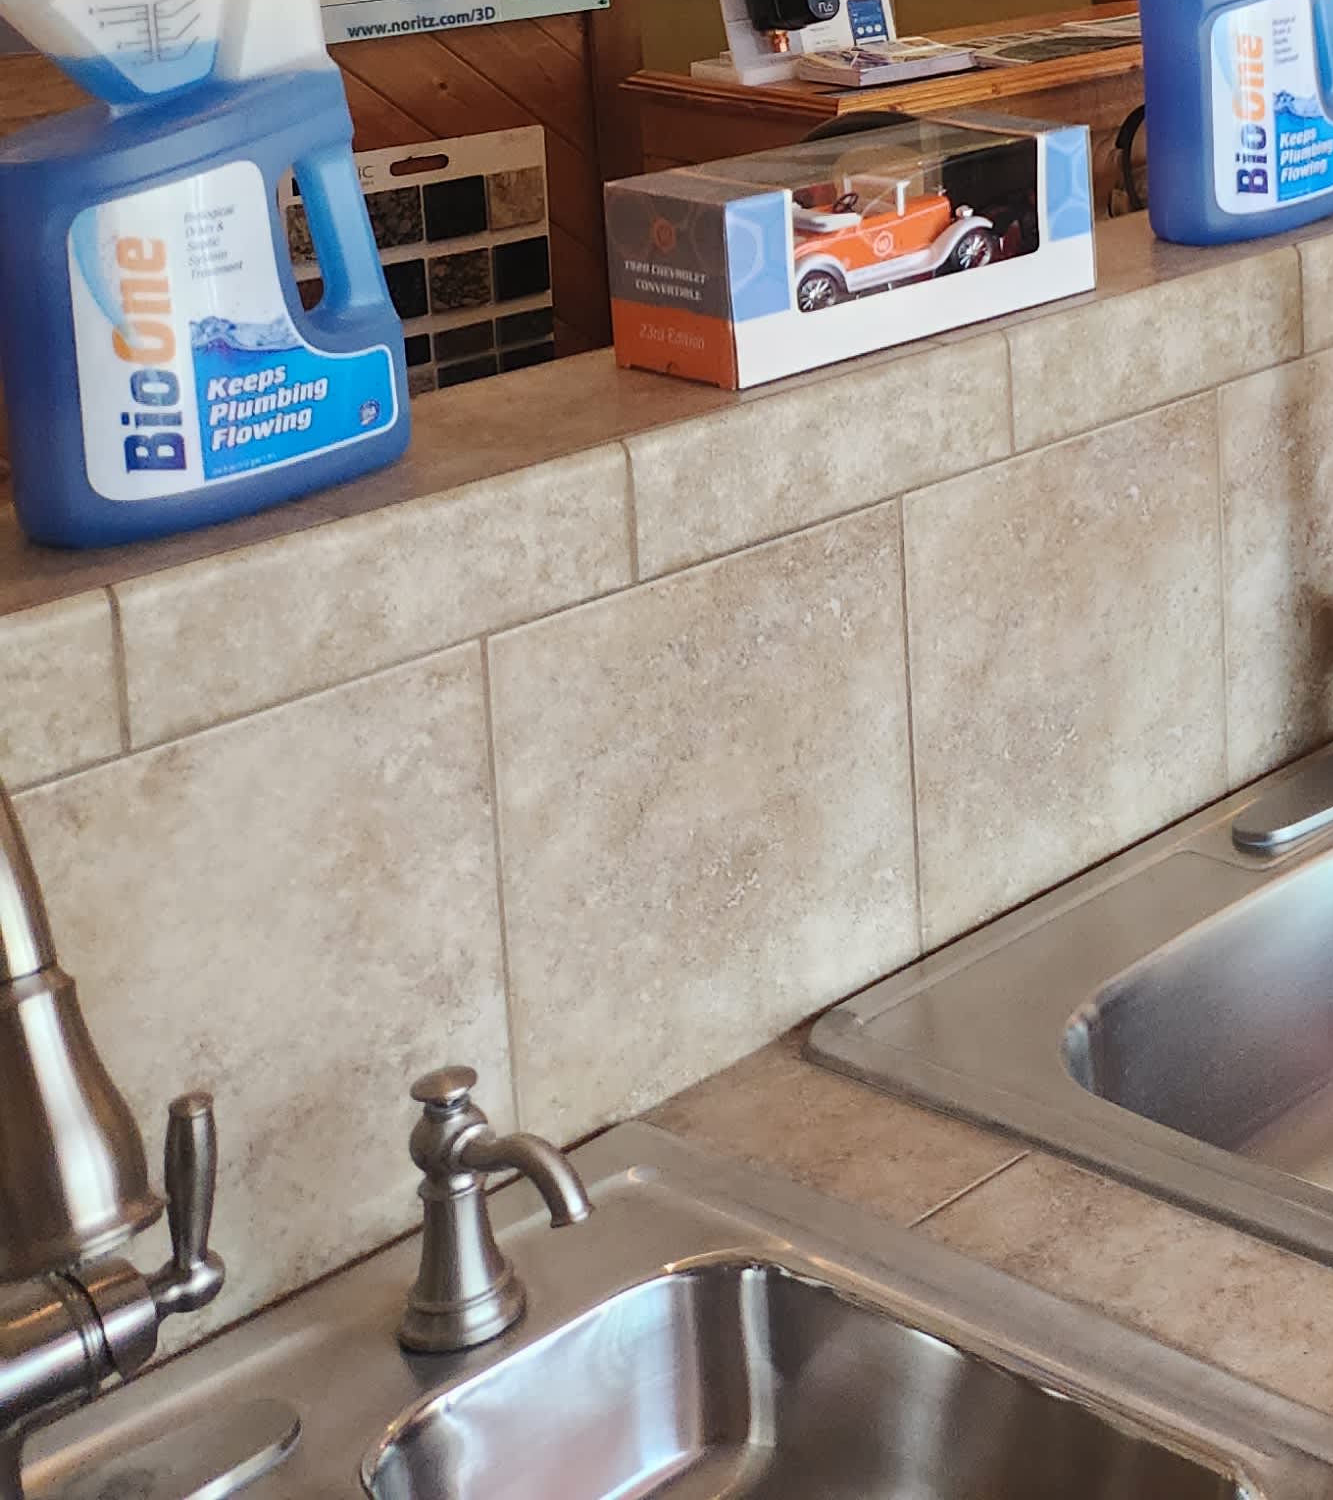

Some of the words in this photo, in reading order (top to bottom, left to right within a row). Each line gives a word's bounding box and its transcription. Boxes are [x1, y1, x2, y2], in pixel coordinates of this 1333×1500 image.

[347, 6, 496, 38] www.noritz.com/3D
[1279, 127, 1317, 150] Keeps
[1280, 159, 1329, 184] Flowing
[207, 365, 286, 401] Keeps
[209, 377, 329, 426] Plumbing
[211, 407, 313, 452] Flowing
